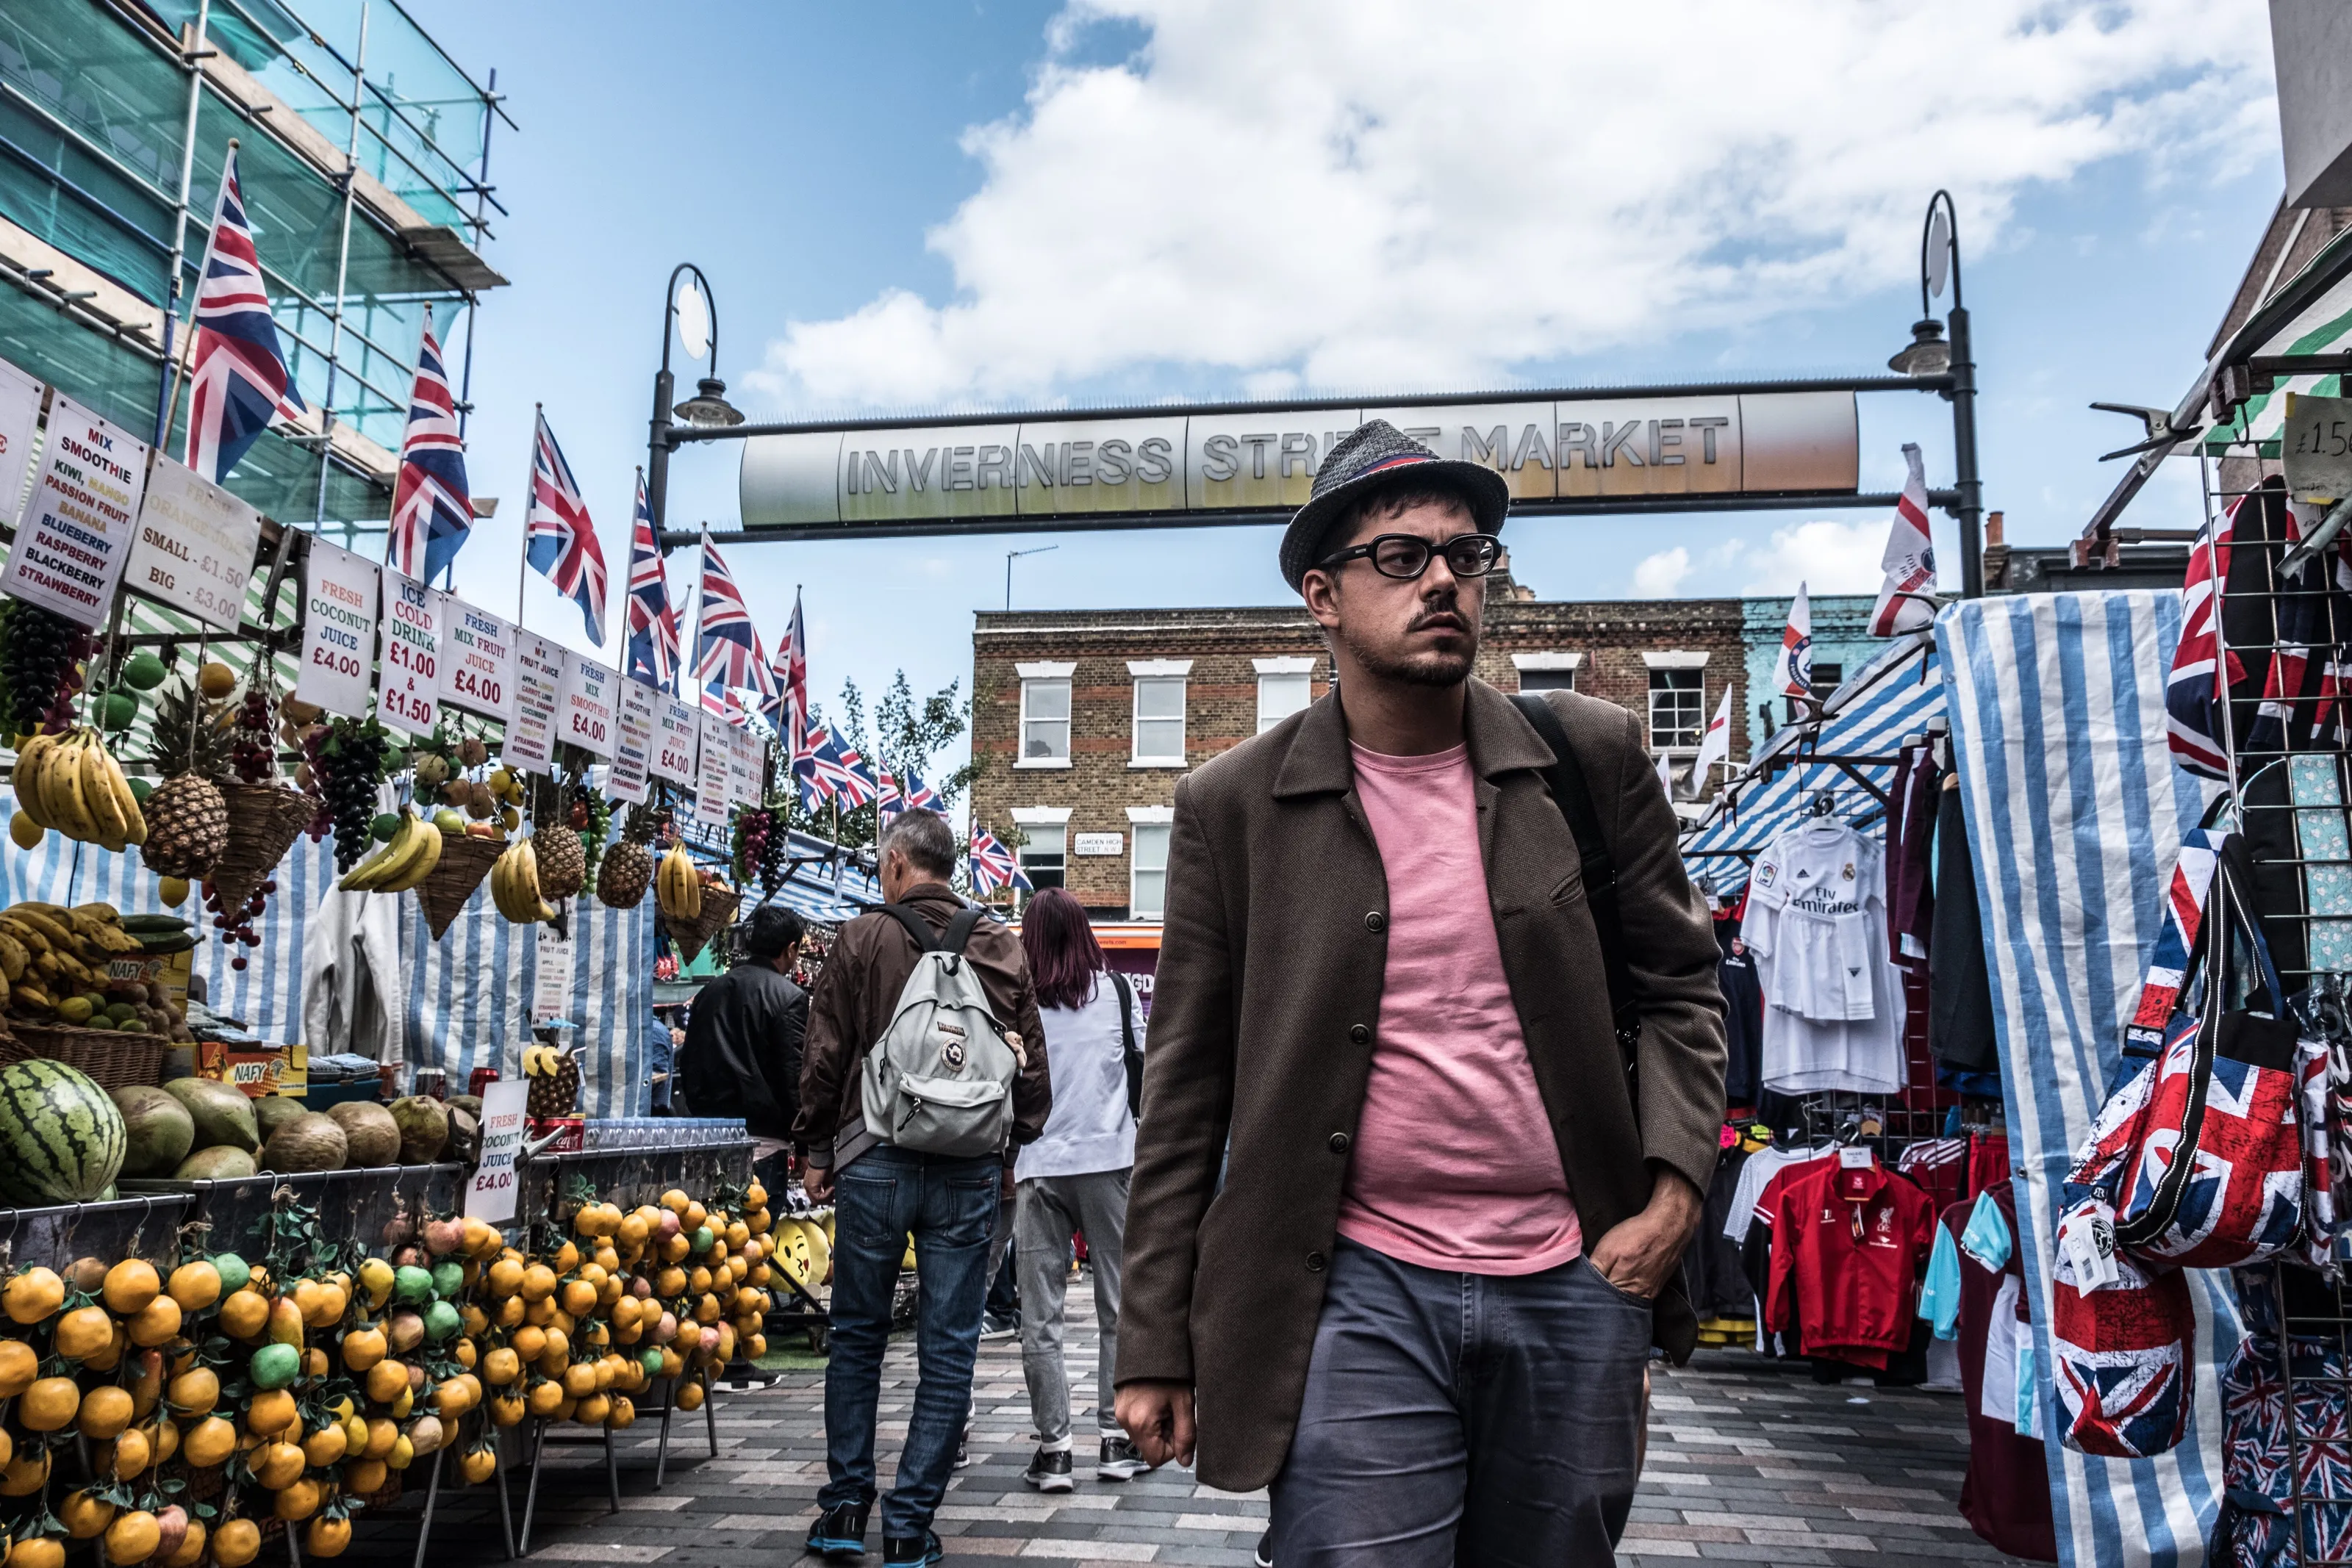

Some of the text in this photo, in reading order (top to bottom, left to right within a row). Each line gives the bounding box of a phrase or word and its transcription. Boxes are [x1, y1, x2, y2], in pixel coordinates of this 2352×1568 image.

[88, 428, 112, 453] MIX
[62, 436, 132, 484] SMOOTHIE
[848, 417, 1728, 495] INVERNESS STRT MARKET
[54, 459, 129, 506] KIWI, MANGO
[46, 474, 129, 524] PASSION FRUIT
[59, 500, 107, 533] BANANA
[150, 495, 209, 538] ORANGE
[42, 514, 112, 554] BLUEBERRY
[36, 531, 107, 571] RASPBERRY
[143, 527, 189, 561] SMALL
[201, 555, 243, 589] £1.50
[26, 547, 106, 590] BLACKBERRY
[18, 564, 101, 607] STRAWBERRY
[148, 567, 175, 590] BIG
[194, 587, 236, 619] £3.00
[322, 579, 363, 608] FRESH
[401, 583, 426, 608] ICE
[311, 598, 370, 633] COCONUT
[395, 601, 432, 630] COLD
[465, 613, 498, 637] FRESH
[320, 625, 358, 650] JUICE
[392, 618, 435, 652] DRINK
[454, 627, 506, 659] MIX FRUIT
[313, 647, 359, 677] £4.00
[390, 641, 434, 678] £1.00
[466, 653, 495, 674] JUICE
[535, 647, 546, 659] MIX
[520, 655, 559, 678] FRUIT JUICE
[581, 663, 605, 683] FRESH
[1790, 663, 1808, 688] FOOTBALL
[407, 677, 415, 691] &
[455, 669, 501, 704] £4.00
[522, 685, 553, 702] CARROT, LIME
[585, 682, 599, 698] MIX
[516, 694, 555, 713] GINGER, ORANGE
[634, 689, 643, 701] MIX
[386, 688, 431, 724] £1.50
[522, 706, 547, 721] CUCUMBER
[571, 694, 609, 719] SMOOTHIE
[625, 700, 650, 717] SMOOTHIE
[669, 705, 689, 722] FRESH
[520, 716, 546, 730] HONEYDEW
[573, 713, 605, 743] £4.00
[621, 723, 650, 741] PASSION FRUIT
[662, 716, 692, 738] MIX FRUIT
[512, 745, 544, 760] WATERMELON
[514, 736, 545, 750] STRAWBERRY
[620, 746, 645, 760] BLUEBERRY
[668, 736, 686, 750] JUICE
[717, 738, 728, 749] JUICE
[731, 746, 750, 761] ORANGE
[617, 756, 642, 771] RASPBERRY
[662, 749, 688, 774] £4.00
[732, 764, 746, 777] SMALL
[614, 766, 642, 781] BLACKBERRY
[612, 777, 641, 792] STRAWBERRY
[702, 805, 723, 815] WATERMELON
[703, 797, 724, 807] STRAWBERRY
[1792, 898, 1860, 914] Emirates
[109, 961, 143, 979] NAFY
[1125, 972, 1155, 993] GD
[234, 1064, 265, 1082] NAFY
[490, 1113, 518, 1129] FRESH
[483, 1152, 512, 1168] JUICE
[476, 1171, 512, 1192] £4.00
